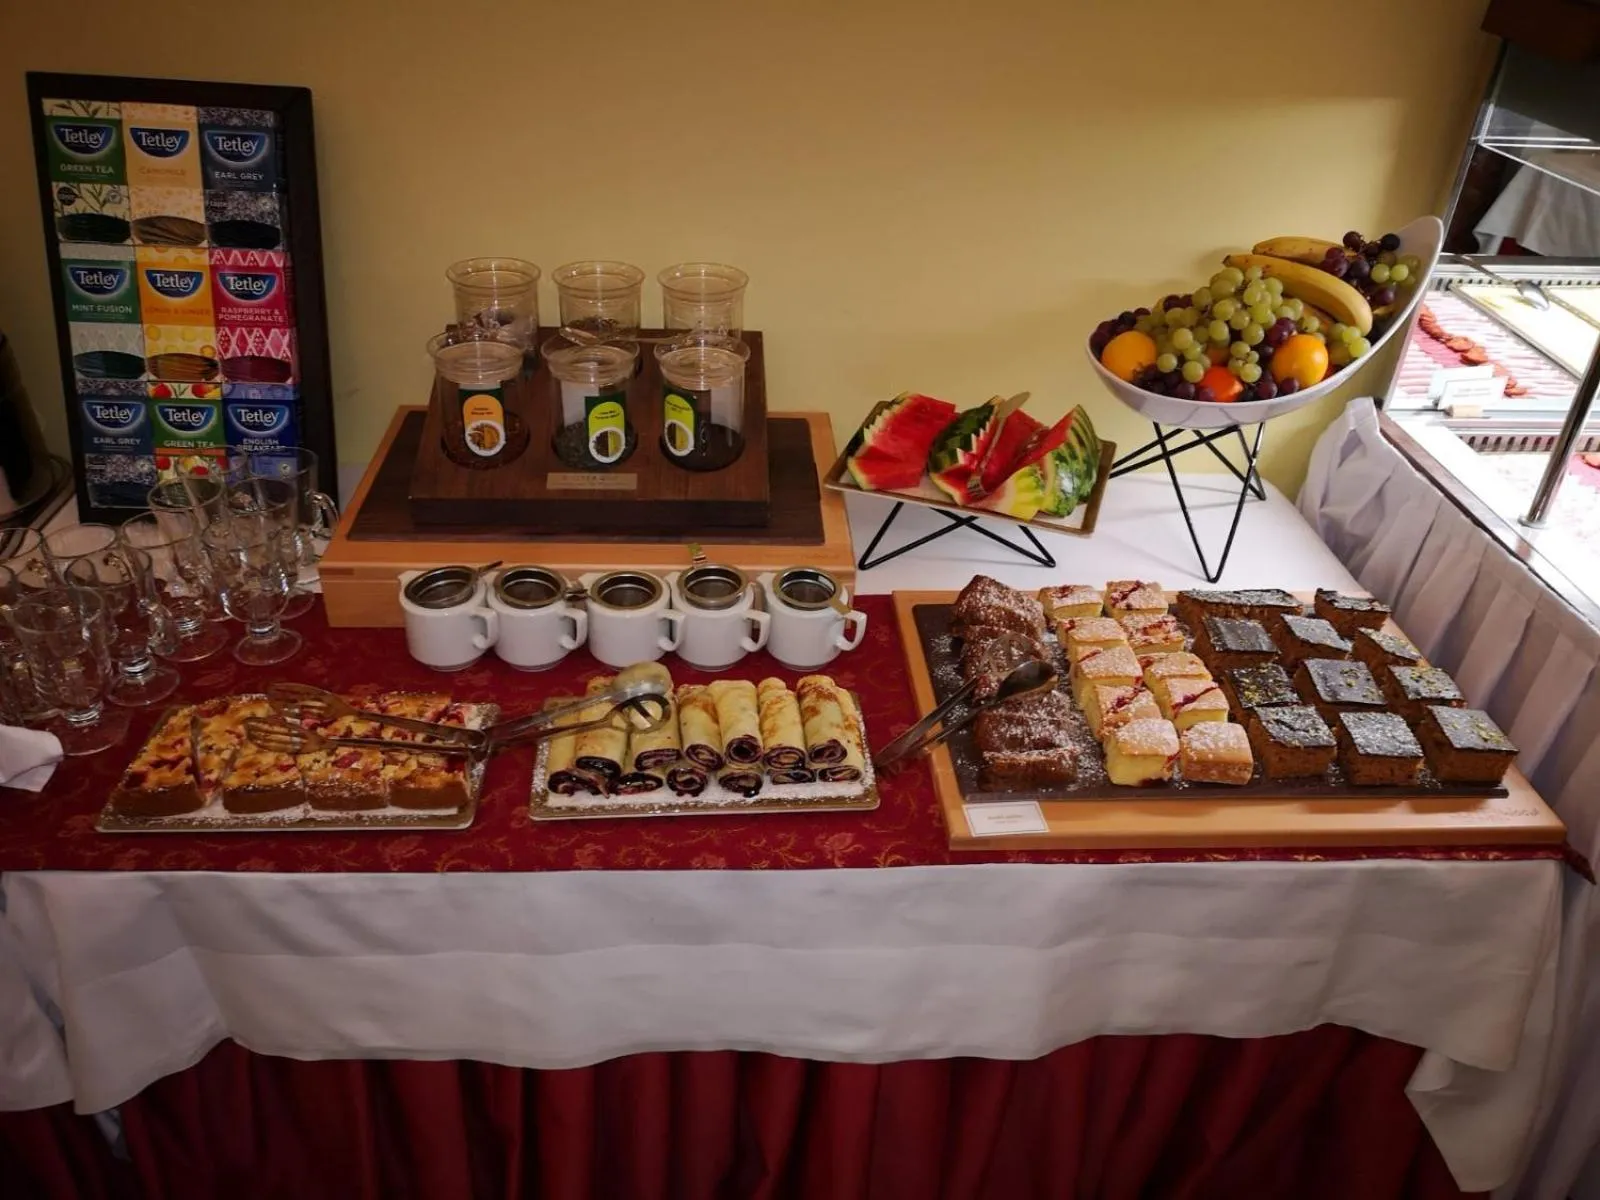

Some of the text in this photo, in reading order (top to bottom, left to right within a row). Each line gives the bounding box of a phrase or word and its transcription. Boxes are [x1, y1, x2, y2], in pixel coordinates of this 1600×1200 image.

[60, 127, 106, 149] Tetley
[137, 131, 183, 153] Tetley
[213, 136, 259, 157] Tetley
[60, 163, 115, 175] GREEN TEA
[214, 171, 265, 181] EARL GREY
[75, 269, 121, 290] Tetley
[152, 273, 197, 293] Tetley
[225, 275, 270, 296] Tetley
[71, 303, 95, 313] MINT
[96, 304, 133, 314] FUSION
[218, 312, 284, 323] POMEGRANATE
[221, 306, 273, 315] RASPBERRY
[92, 404, 136, 424] Tetley
[163, 407, 208, 427] Tetley
[236, 408, 281, 427] Tetley
[92, 436, 142, 446] EARL GREY
[163, 440, 215, 449] GREEN TEA
[242, 438, 280, 446] ENGLISH
